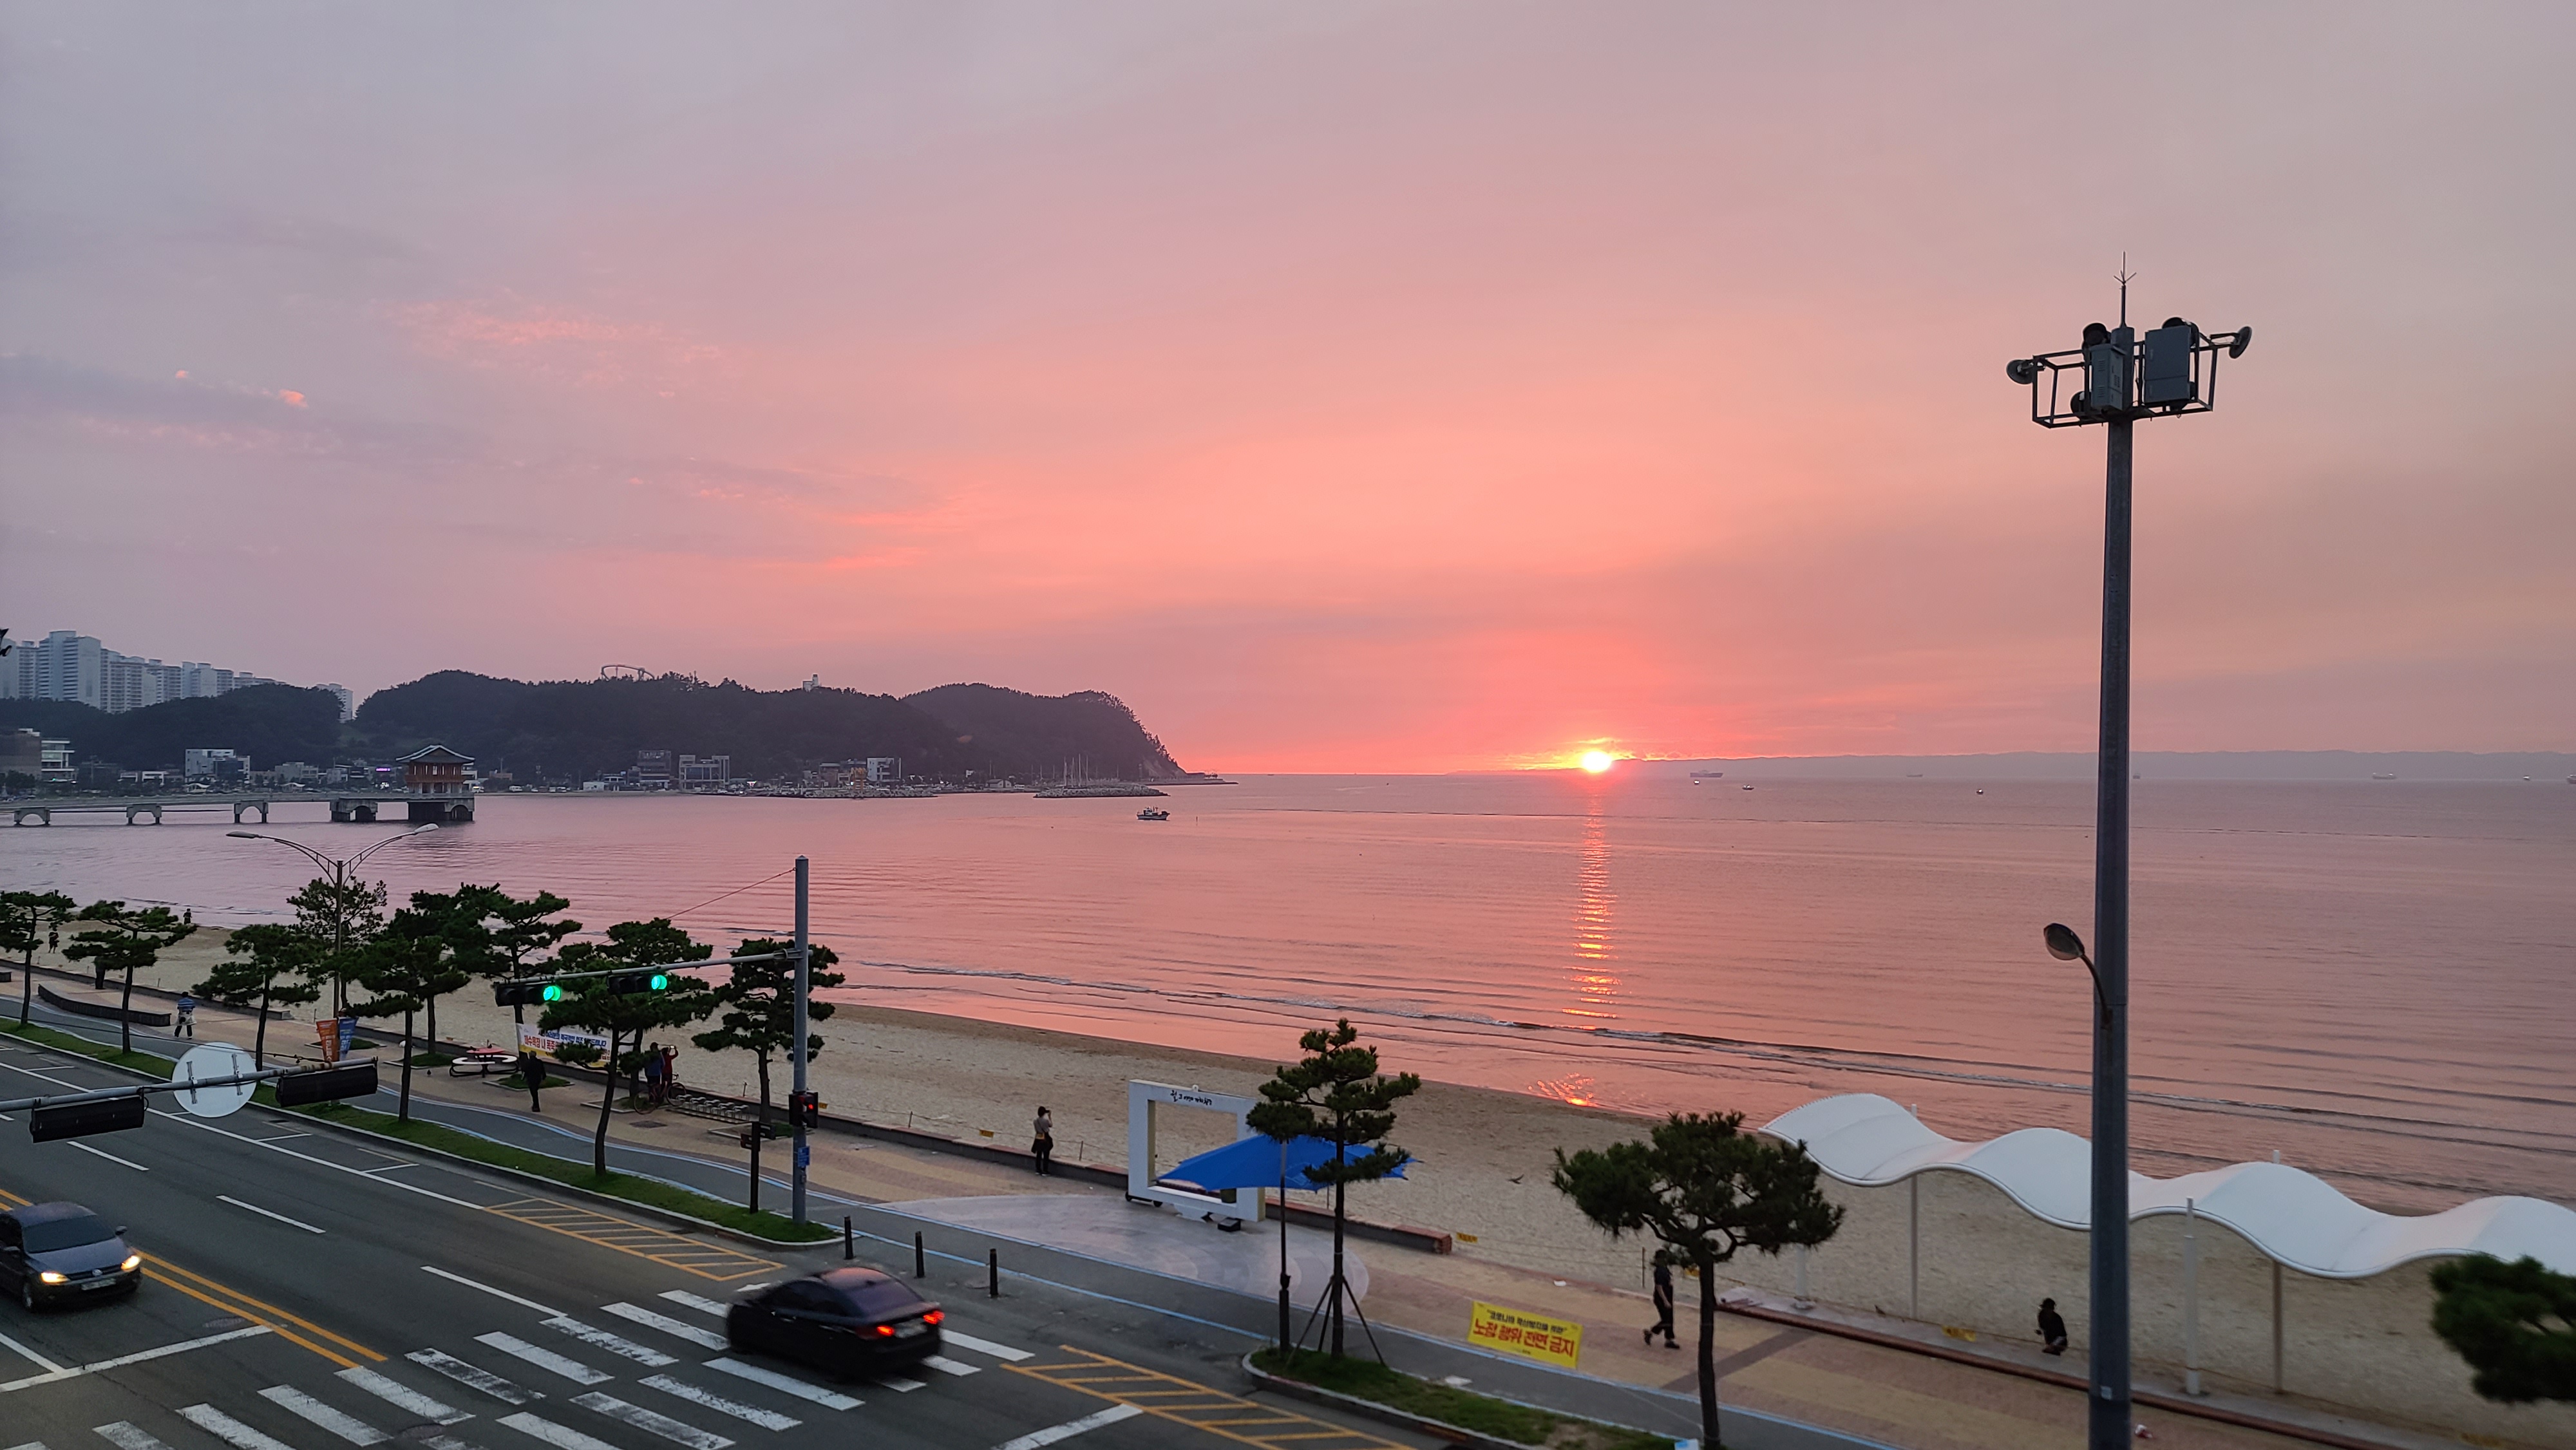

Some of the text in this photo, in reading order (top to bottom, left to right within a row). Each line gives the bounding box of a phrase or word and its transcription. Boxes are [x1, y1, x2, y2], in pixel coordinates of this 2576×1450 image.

[524, 1035, 540, 1048] 해수욕장
[1473, 1318, 1575, 1357] 노점 행위 전면 금지
